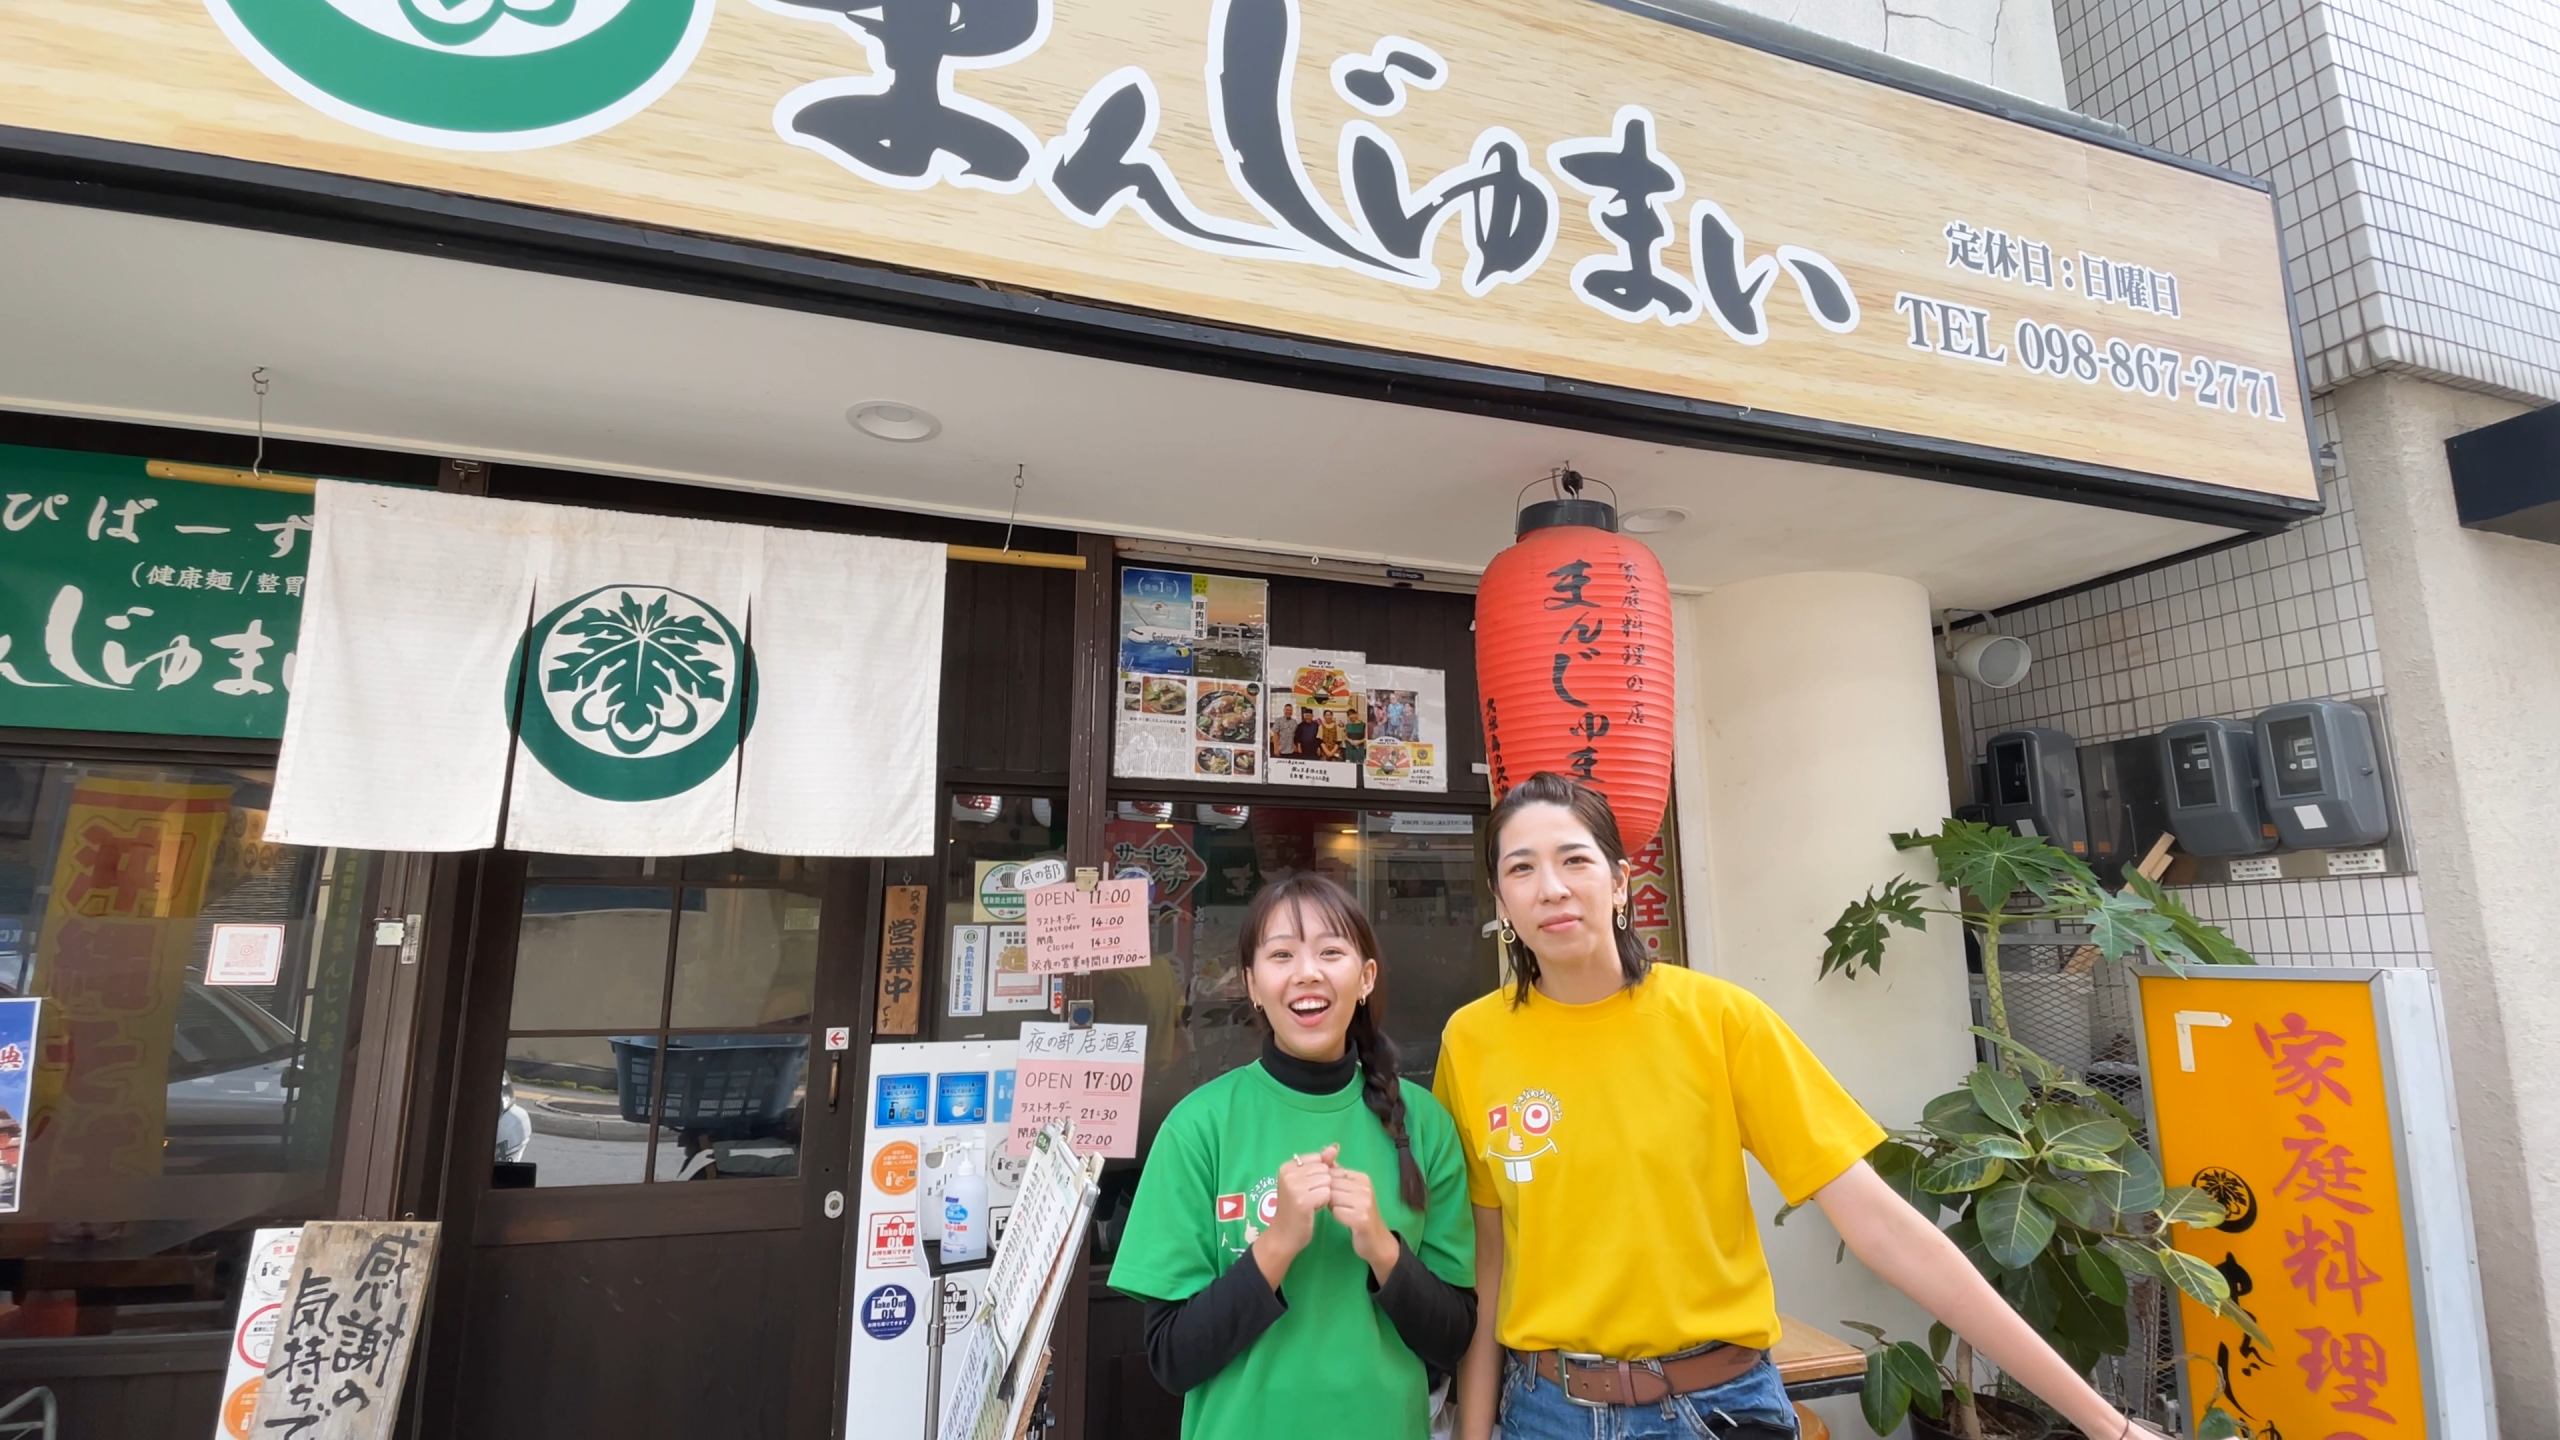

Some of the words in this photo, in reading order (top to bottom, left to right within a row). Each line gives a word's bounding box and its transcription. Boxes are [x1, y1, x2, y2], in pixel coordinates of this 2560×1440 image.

[1899, 294, 2005, 363] TEL
[2018, 321, 2284, 420] 098-867-2771
[1543, 559, 1611, 798] まんじゅま
[1019, 863, 1062, 886] 昼の部
[1034, 891, 1075, 907] OPEN
[1089, 889, 1131, 904] 11:00
[1630, 836, 1673, 963] 安全・
[1091, 916, 1124, 927] 14:00
[1091, 936, 1121, 947] 14:30
[884, 918, 917, 1004] 営業中
[881, 1005, 892, 1029] です
[1026, 1028, 1075, 1054] 夜の部
[1077, 1028, 1139, 1054] 居酒屋
[1025, 1072, 1073, 1089] OPEN
[1083, 1070, 1133, 1092] 17:00
[1021, 1101, 1073, 1114] ラストオーダー
[1080, 1107, 1118, 1121] 21:30
[1075, 1133, 1113, 1146] 22:00
[878, 1223, 898, 1237] Take
[2253, 1012, 2397, 1440] 家庭料理
[886, 1236, 905, 1248] OK
[873, 1297, 890, 1309] Take
[891, 1296, 908, 1308] Out
[881, 1309, 897, 1320] OK
